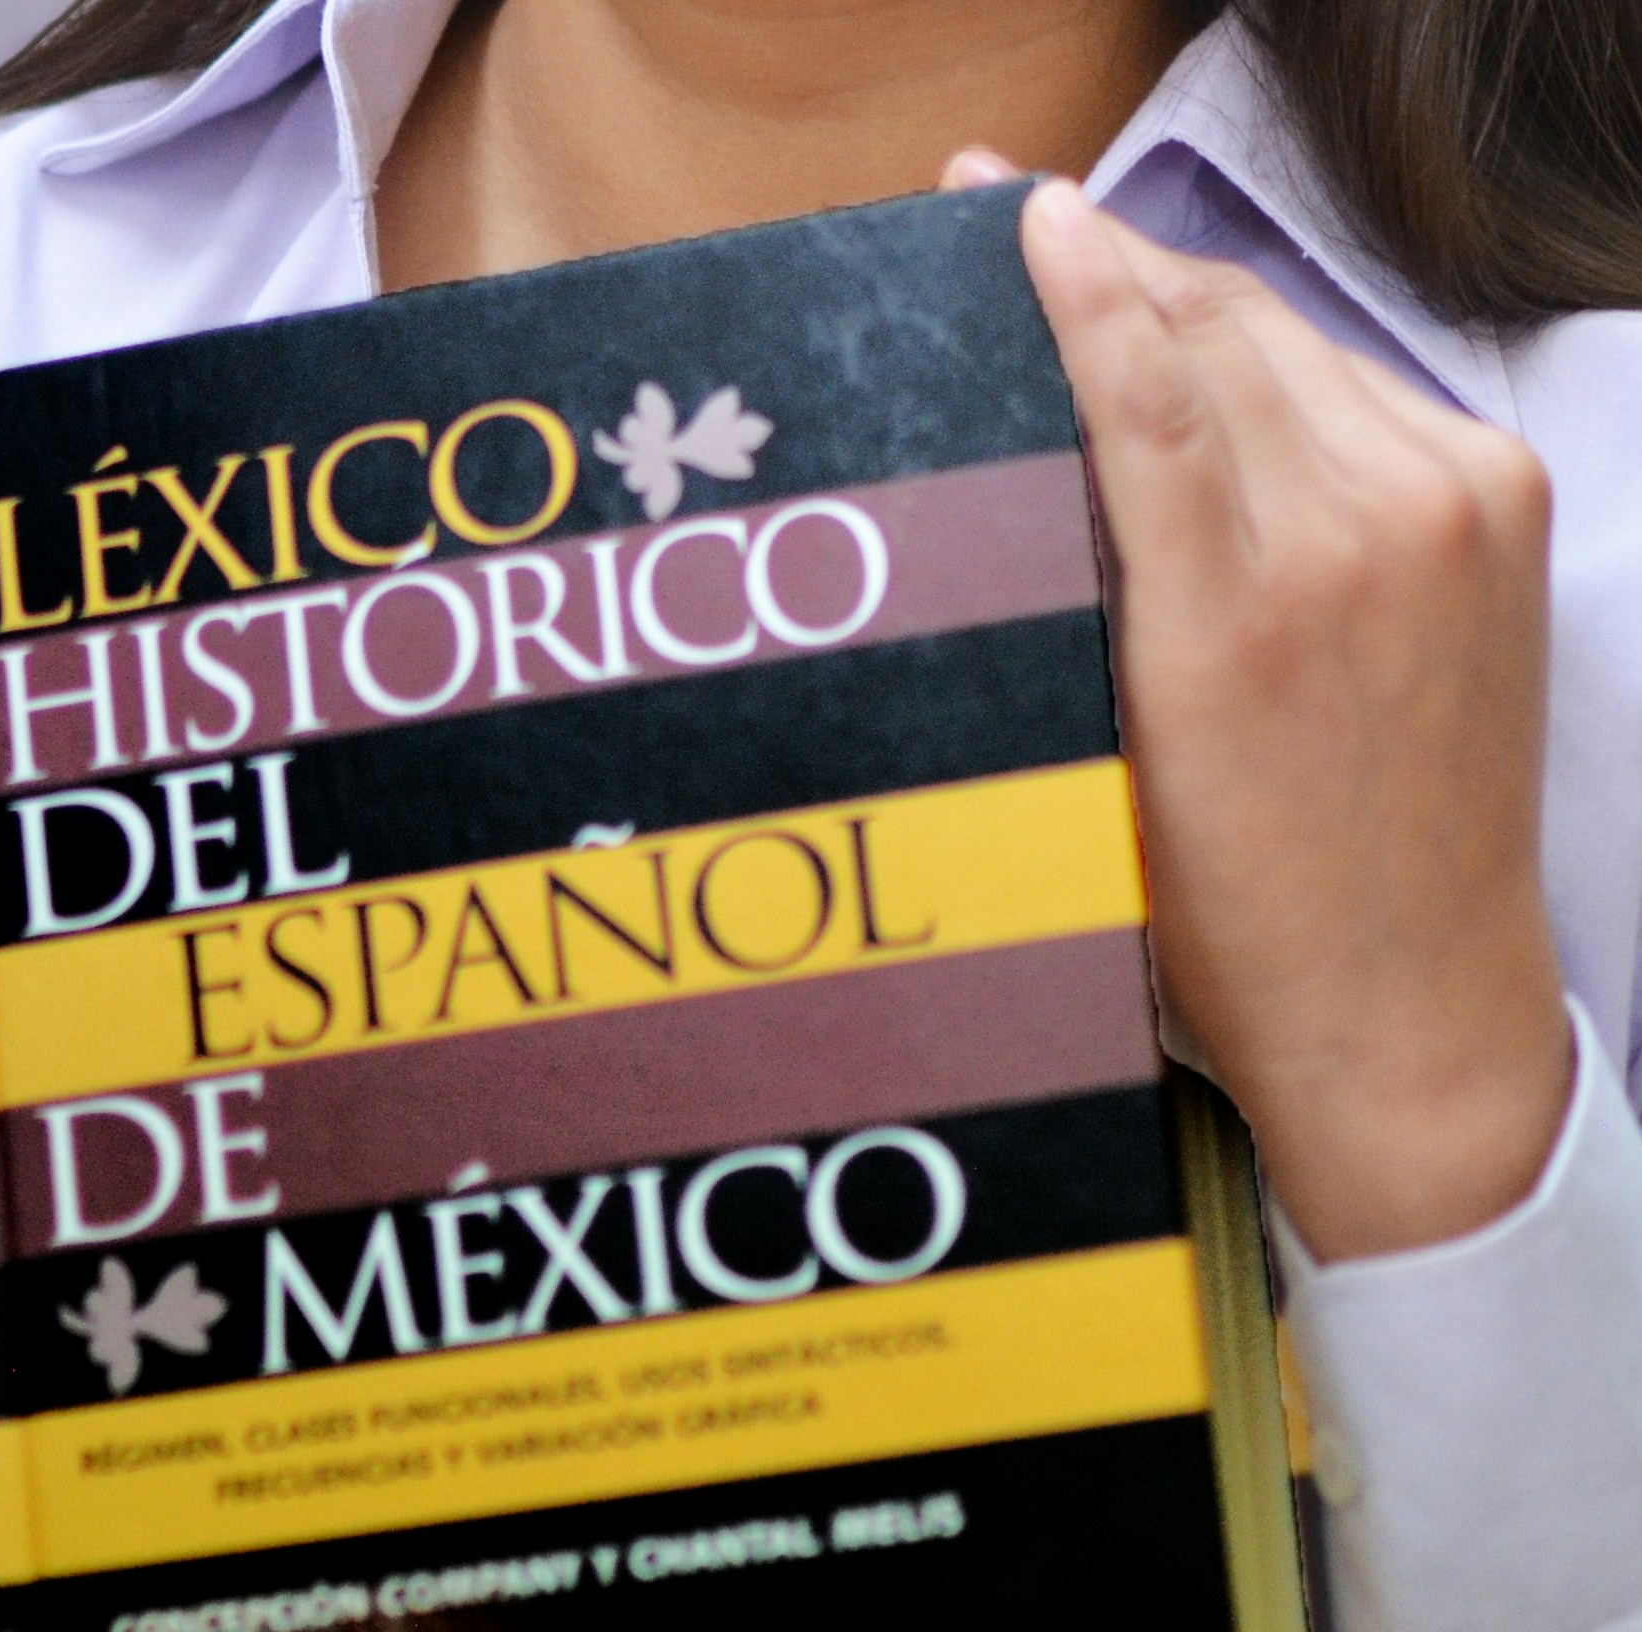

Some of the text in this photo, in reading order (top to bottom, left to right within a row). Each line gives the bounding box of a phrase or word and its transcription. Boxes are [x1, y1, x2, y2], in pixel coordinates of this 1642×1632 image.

[7, 752, 350, 939] DEL
[174, 818, 935, 1064] ESPAÑOL
[34, 1071, 280, 1250] DE
[260, 1158, 966, 1373] MÉXICO
[215, 1386, 823, 1507] FRECUENCIAS Y VARIACIÓN GRÁFICA
[243, 1410, 358, 1452] CLASES
[617, 1355, 713, 1398] USOS
[375, 1551, 582, 1618] COMPANY
[591, 1543, 622, 1588] Y
[626, 1516, 823, 1583] CHANTAL
[830, 1489, 967, 1553] MELIS
